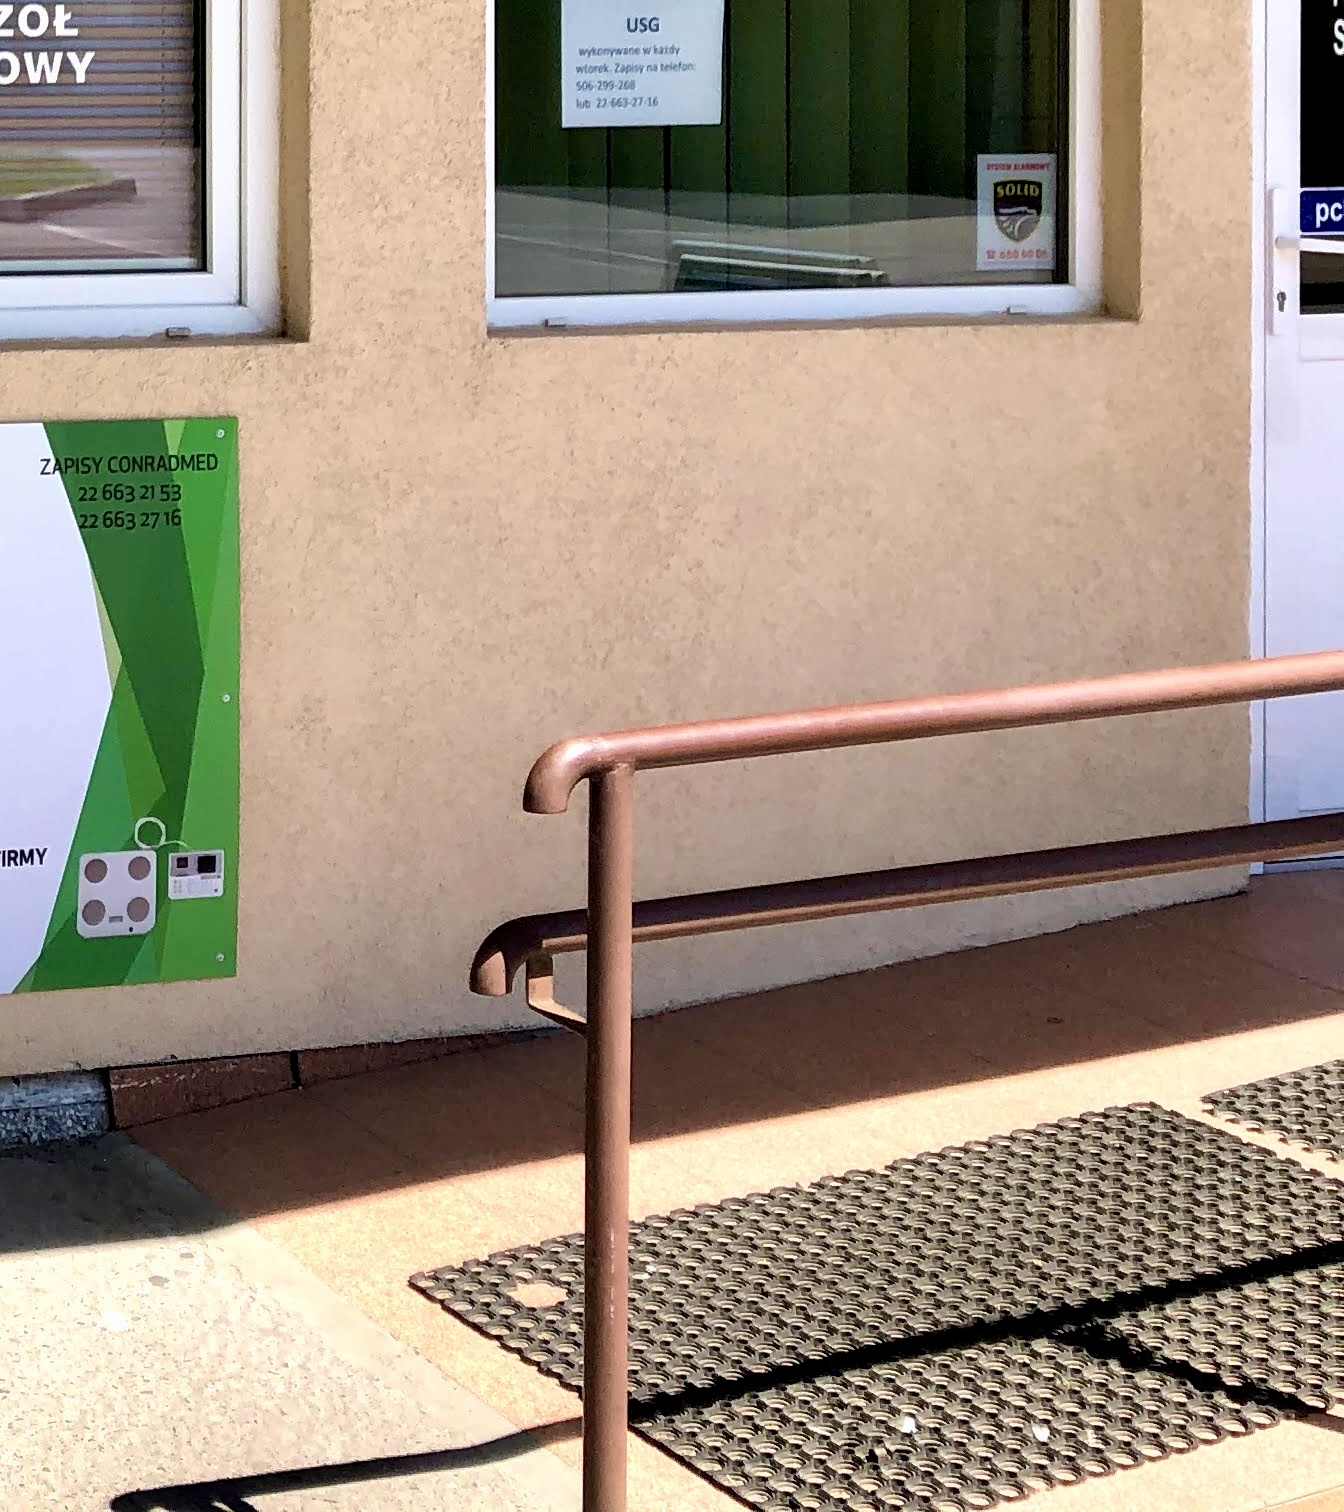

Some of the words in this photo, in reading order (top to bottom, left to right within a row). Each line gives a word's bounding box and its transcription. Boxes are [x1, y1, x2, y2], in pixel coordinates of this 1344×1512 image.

[627, 17, 659, 33] USG
[615, 63, 644, 74] Zapisy
[647, 64, 658, 72] na
[996, 183, 1040, 198] SOLID
[1315, 197, 1344, 229] pc
[39, 456, 103, 476] ZAPISY
[107, 453, 219, 474] CONRADMED
[78, 486, 98, 502] 22
[102, 483, 136, 503] 663
[139, 484, 155, 500] 21
[160, 484, 182, 502] 53
[78, 513, 98, 529] 22
[102, 510, 136, 531] 663
[140, 512, 160, 529] 27
[164, 508, 182, 527] 16
